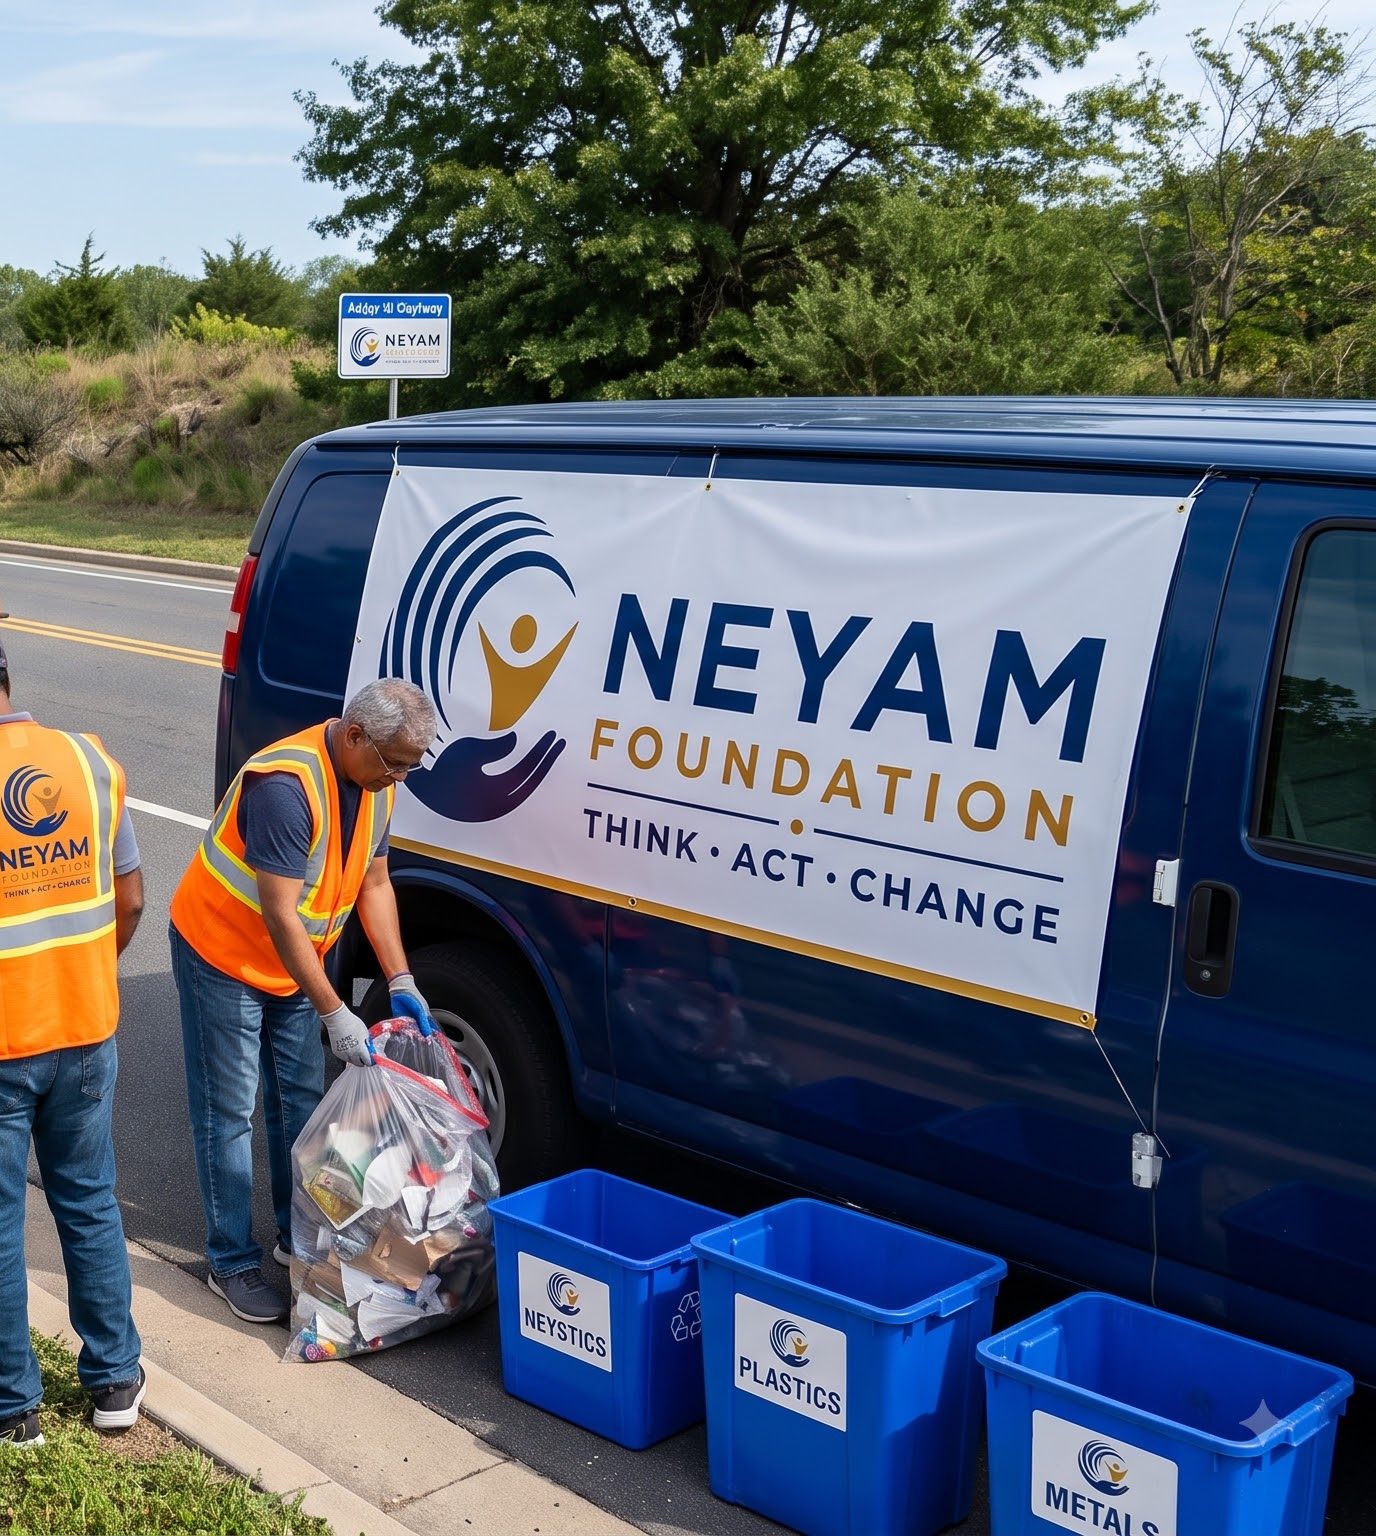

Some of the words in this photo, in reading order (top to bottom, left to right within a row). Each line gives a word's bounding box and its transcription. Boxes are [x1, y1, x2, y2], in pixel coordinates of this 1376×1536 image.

[385, 334, 440, 346] NEYAM
[602, 593, 1106, 763] NEYAM
[589, 718, 1074, 847] FOUNDATION
[2, 860, 91, 884] FOUNDATION
[4, 888, 30, 899] THINK
[37, 884, 51, 893] ACT
[583, 808, 698, 862] THINK
[731, 843, 814, 887] ACT
[850, 868, 1060, 944] CHANGE
[525, 1307, 606, 1358] NEYSTICS
[739, 1355, 841, 1415] PLASTICS
